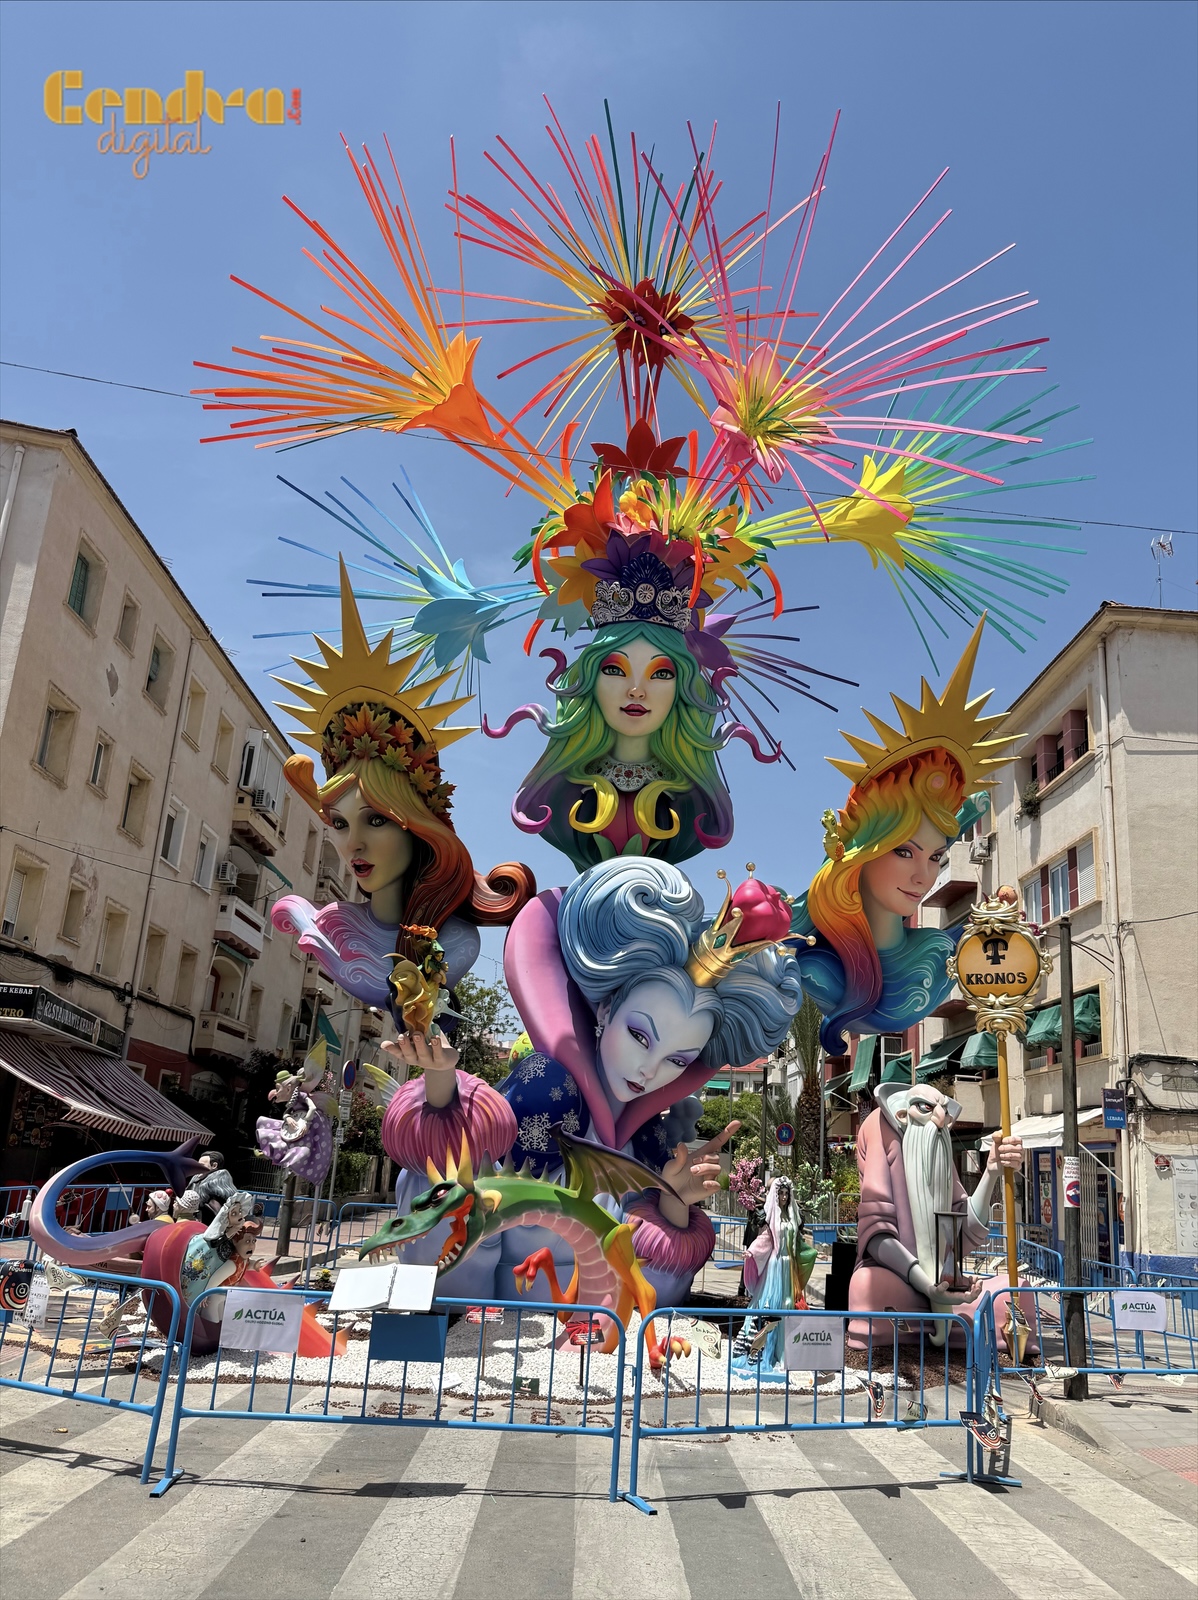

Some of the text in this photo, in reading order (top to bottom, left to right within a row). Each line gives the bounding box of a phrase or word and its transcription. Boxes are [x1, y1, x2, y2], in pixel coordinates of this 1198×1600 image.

[966, 972, 1028, 985] KRONOS
[9, 987, 34, 995] KEBAB
[1129, 1302, 1157, 1310] ACTÚA
[244, 1308, 286, 1321] ACTÚA
[801, 1330, 832, 1342] ACTÚA
